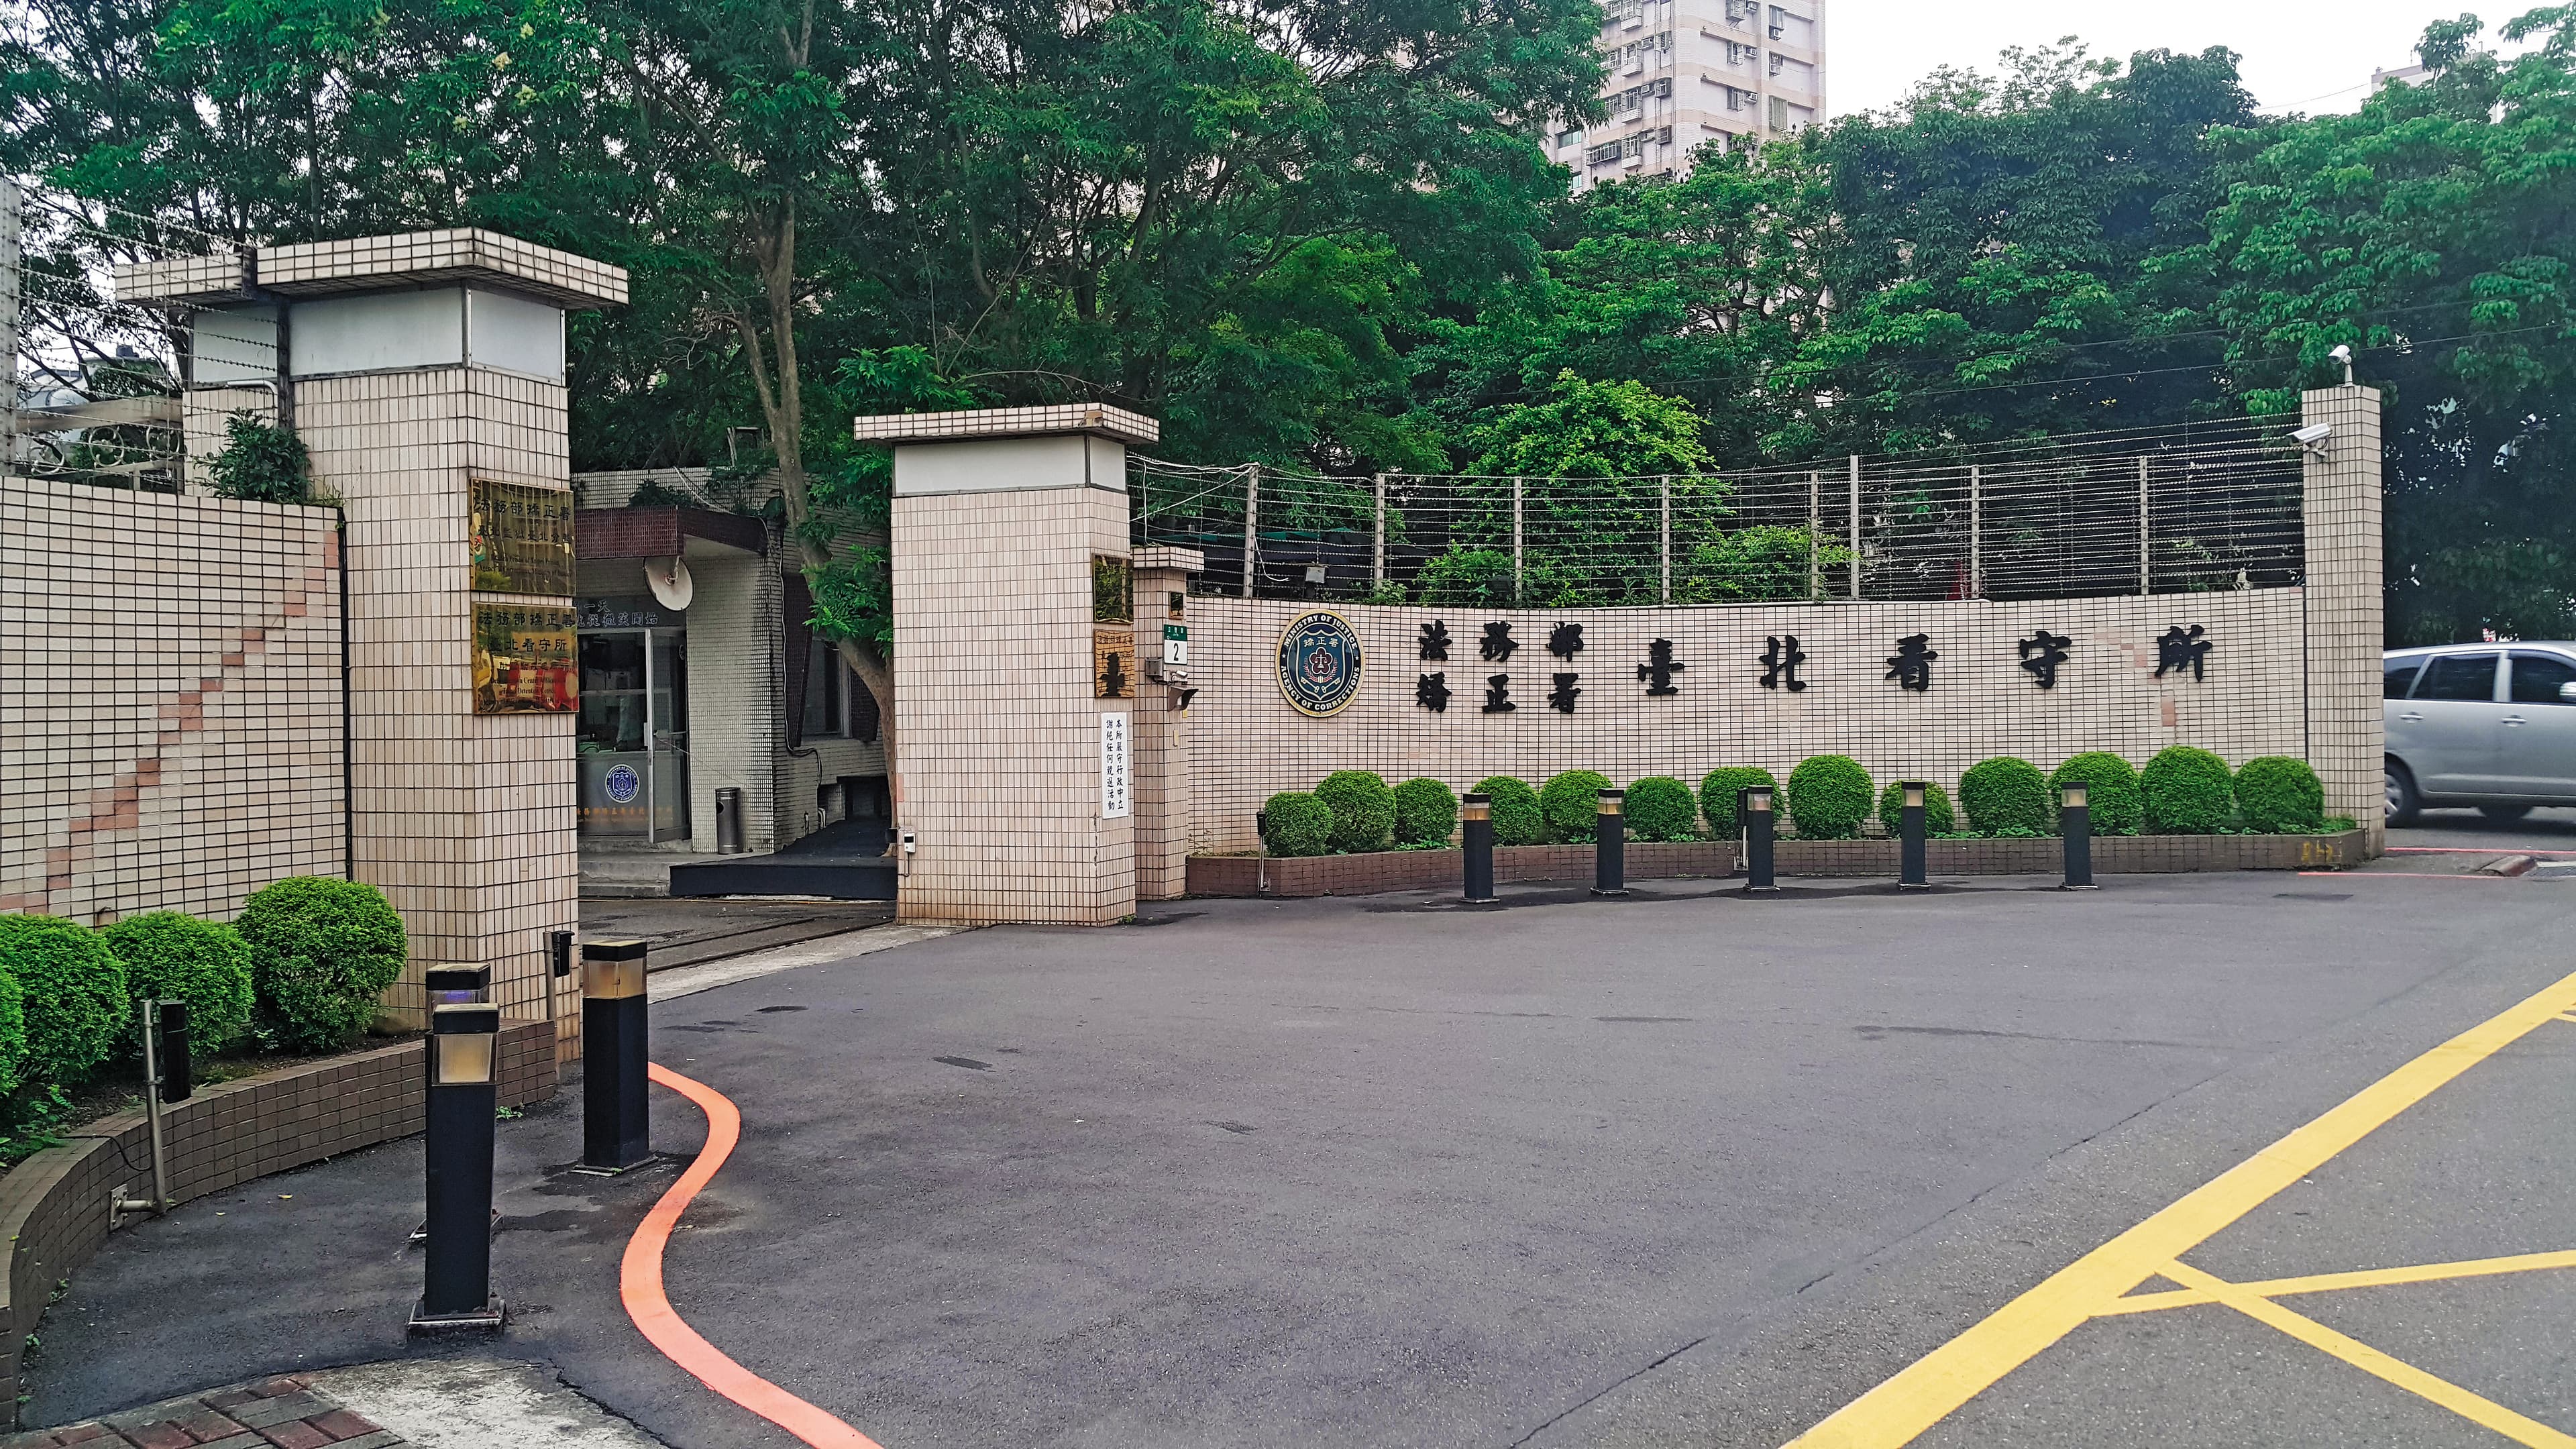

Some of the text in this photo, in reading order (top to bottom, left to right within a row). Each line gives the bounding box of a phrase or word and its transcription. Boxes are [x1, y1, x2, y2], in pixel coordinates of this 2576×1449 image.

[474, 498, 570, 520] 法務部矯正署
[478, 611, 576, 627] 法務部矯正署
[1284, 615, 1318, 647] MINISTRY
[1332, 619, 1358, 649] JUSTICE
[489, 638, 567, 652] 臺北看守所
[1173, 643, 1179, 661] 2
[1303, 637, 1339, 647] 矯正署
[1419, 621, 1583, 662] 法務部
[1638, 625, 2212, 696] 臺北看守所
[1281, 666, 1360, 710] AGENCY OF CORRECTIONS
[1417, 672, 1580, 714] 矯正署
[1106, 719, 1115, 810] 謝絕任何競選活動
[1116, 719, 1124, 810] 本所嚴守行政中立
